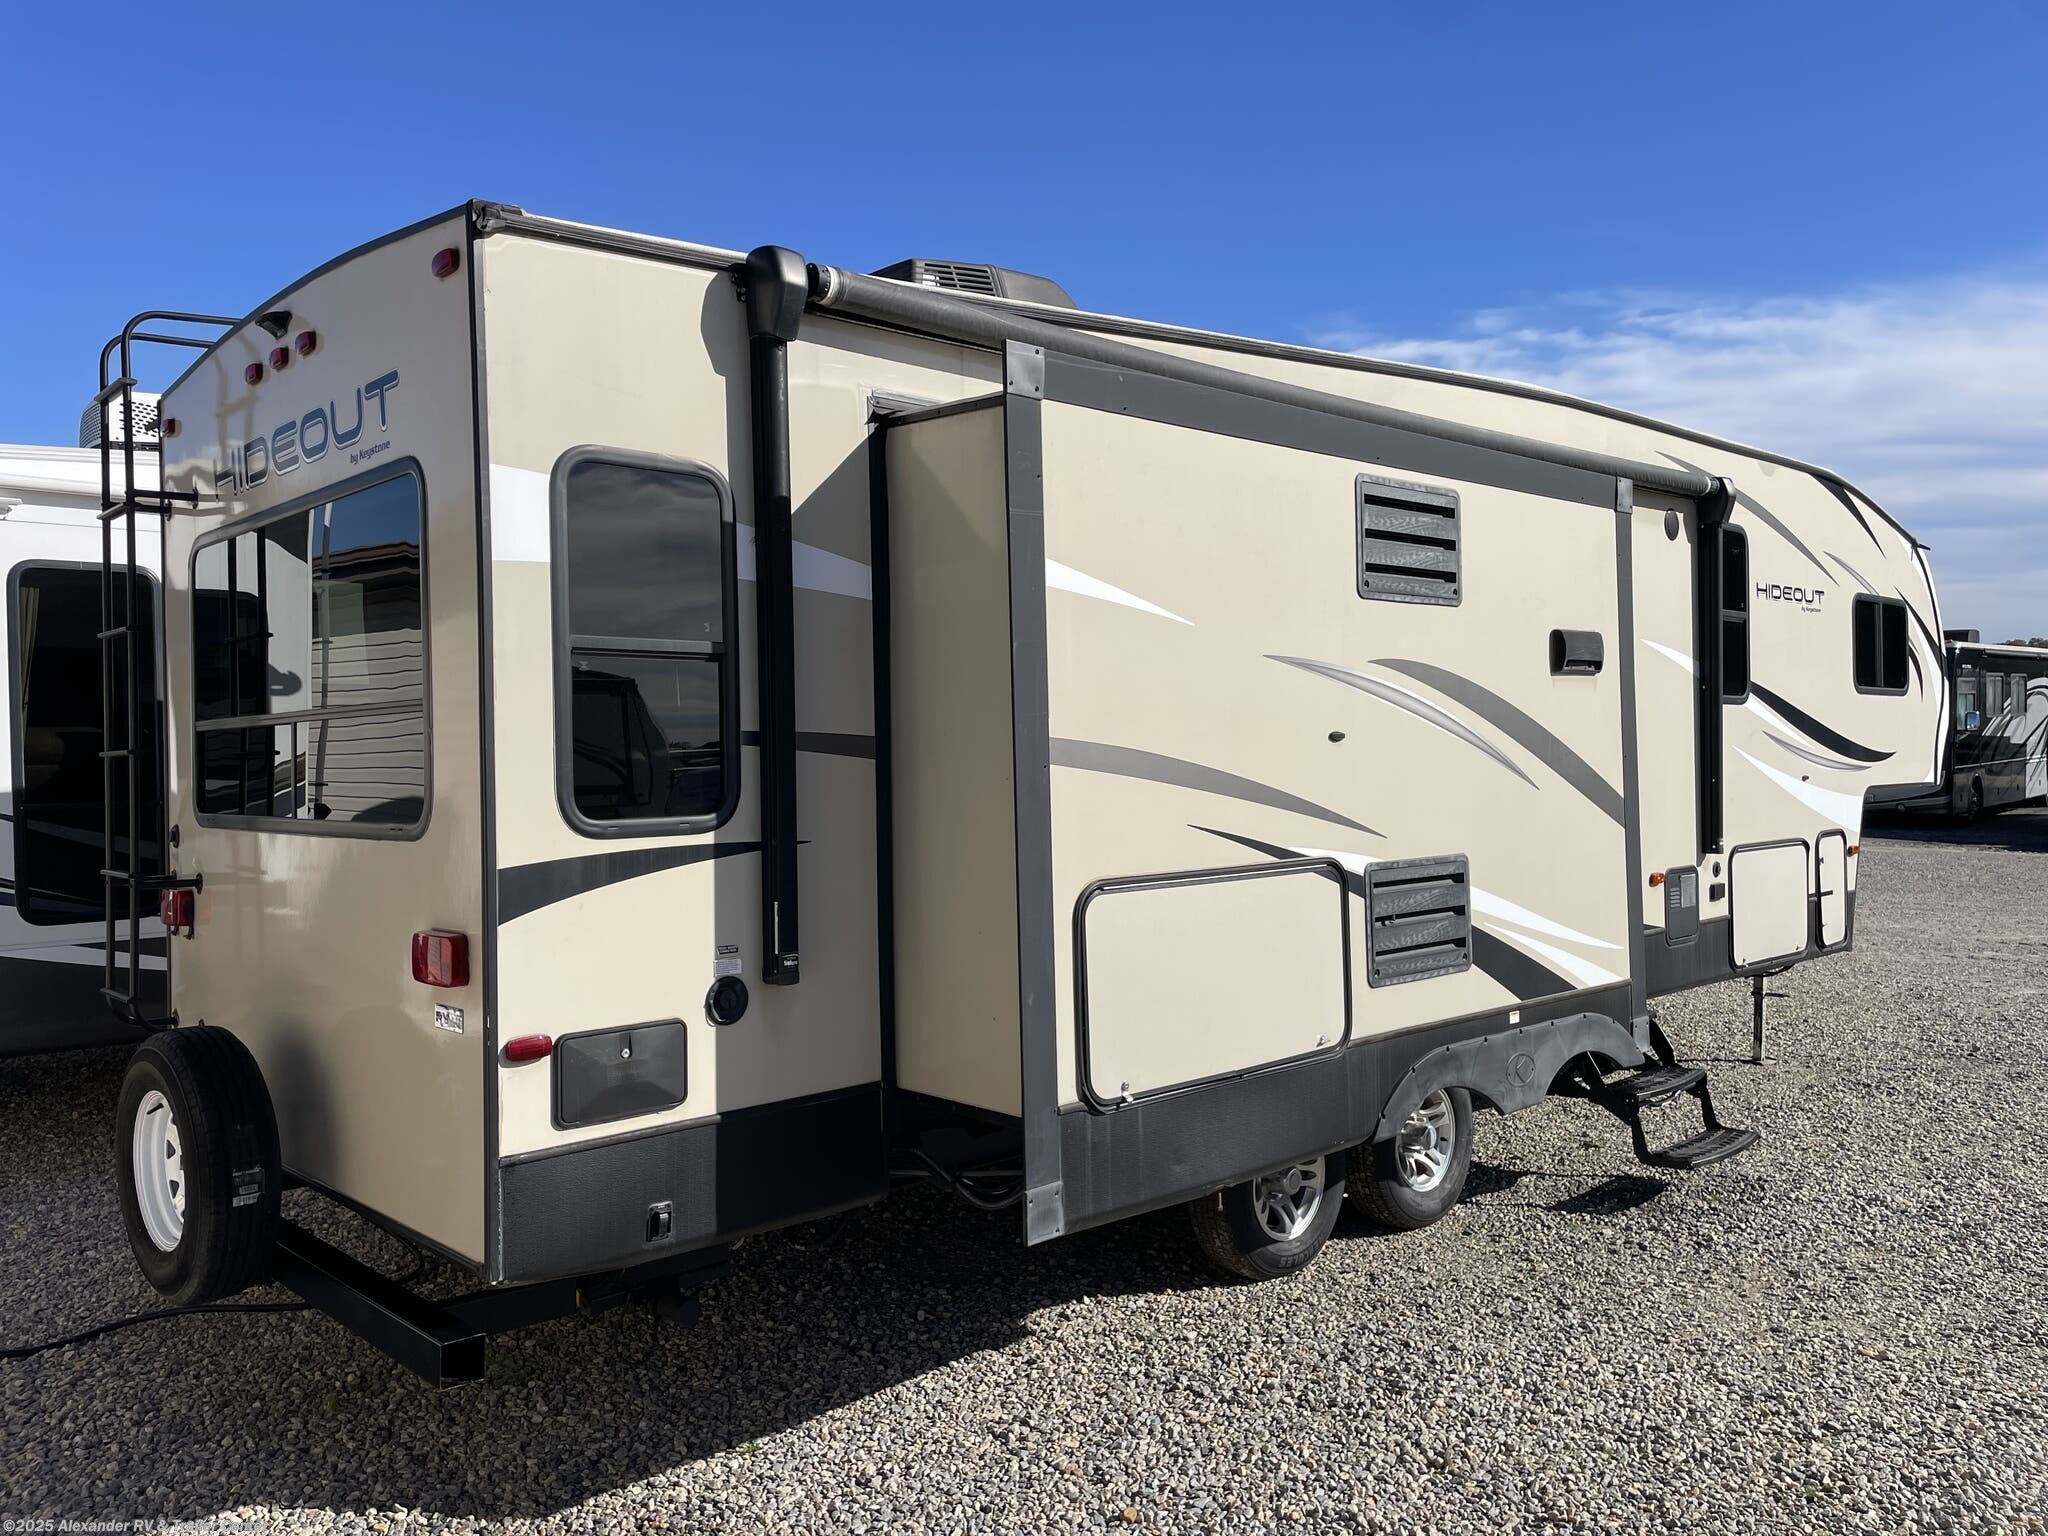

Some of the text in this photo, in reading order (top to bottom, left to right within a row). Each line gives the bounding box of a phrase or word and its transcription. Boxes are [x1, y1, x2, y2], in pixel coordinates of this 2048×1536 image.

[214, 369, 400, 502] HIDEOUT
[350, 440, 391, 465] by Keystone
[1756, 582, 1824, 604] HIDEOUT
